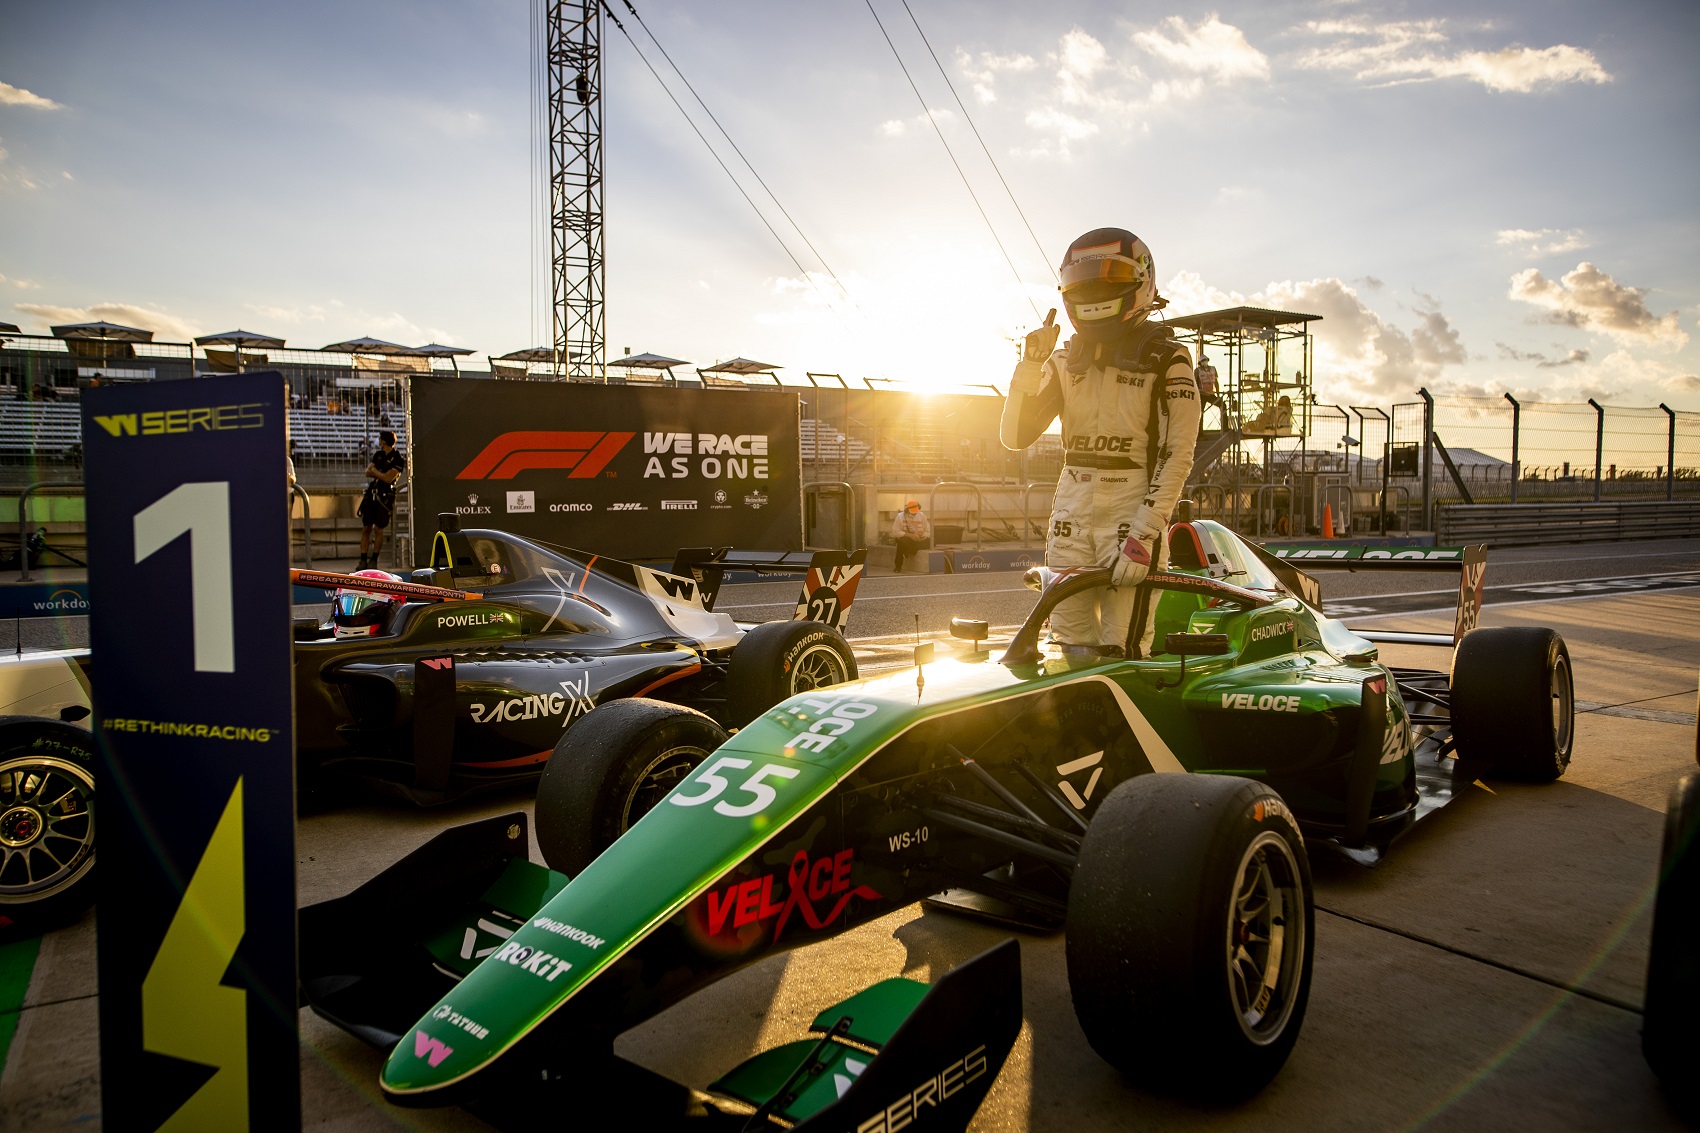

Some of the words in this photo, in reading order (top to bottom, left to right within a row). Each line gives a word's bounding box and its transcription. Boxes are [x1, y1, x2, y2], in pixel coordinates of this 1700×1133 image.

[142, 403, 264, 435] SERIES
[643, 432, 692, 454] WE
[698, 433, 768, 455] RACE
[1066, 435, 1134, 453] VELOCE
[605, 471, 618, 479] TM
[643, 456, 689, 479] AS
[701, 457, 769, 479] ONE
[455, 506, 492, 515] ROLEX
[549, 503, 593, 512] aramco
[611, 502, 644, 511] DHL
[661, 500, 698, 510] PIRELLI
[1053, 520, 1072, 538] 55
[133, 481, 235, 673] 1
[961, 561, 991, 571] workday
[300, 574, 466, 600] #BREASTCANCERAWARENESSMONTH
[437, 614, 489, 628] POWELL
[811, 597, 837, 624] 27
[1463, 600, 1476, 635] 55
[1251, 621, 1287, 642] CHADWICK
[470, 691, 566, 724] RACING
[1221, 693, 1301, 713] VELOCE
[103, 718, 271, 742] #RETHINKRACING
[668, 756, 801, 818] 55
[889, 826, 929, 853] WS-10
[447, 1012, 490, 1041] TATUUS
